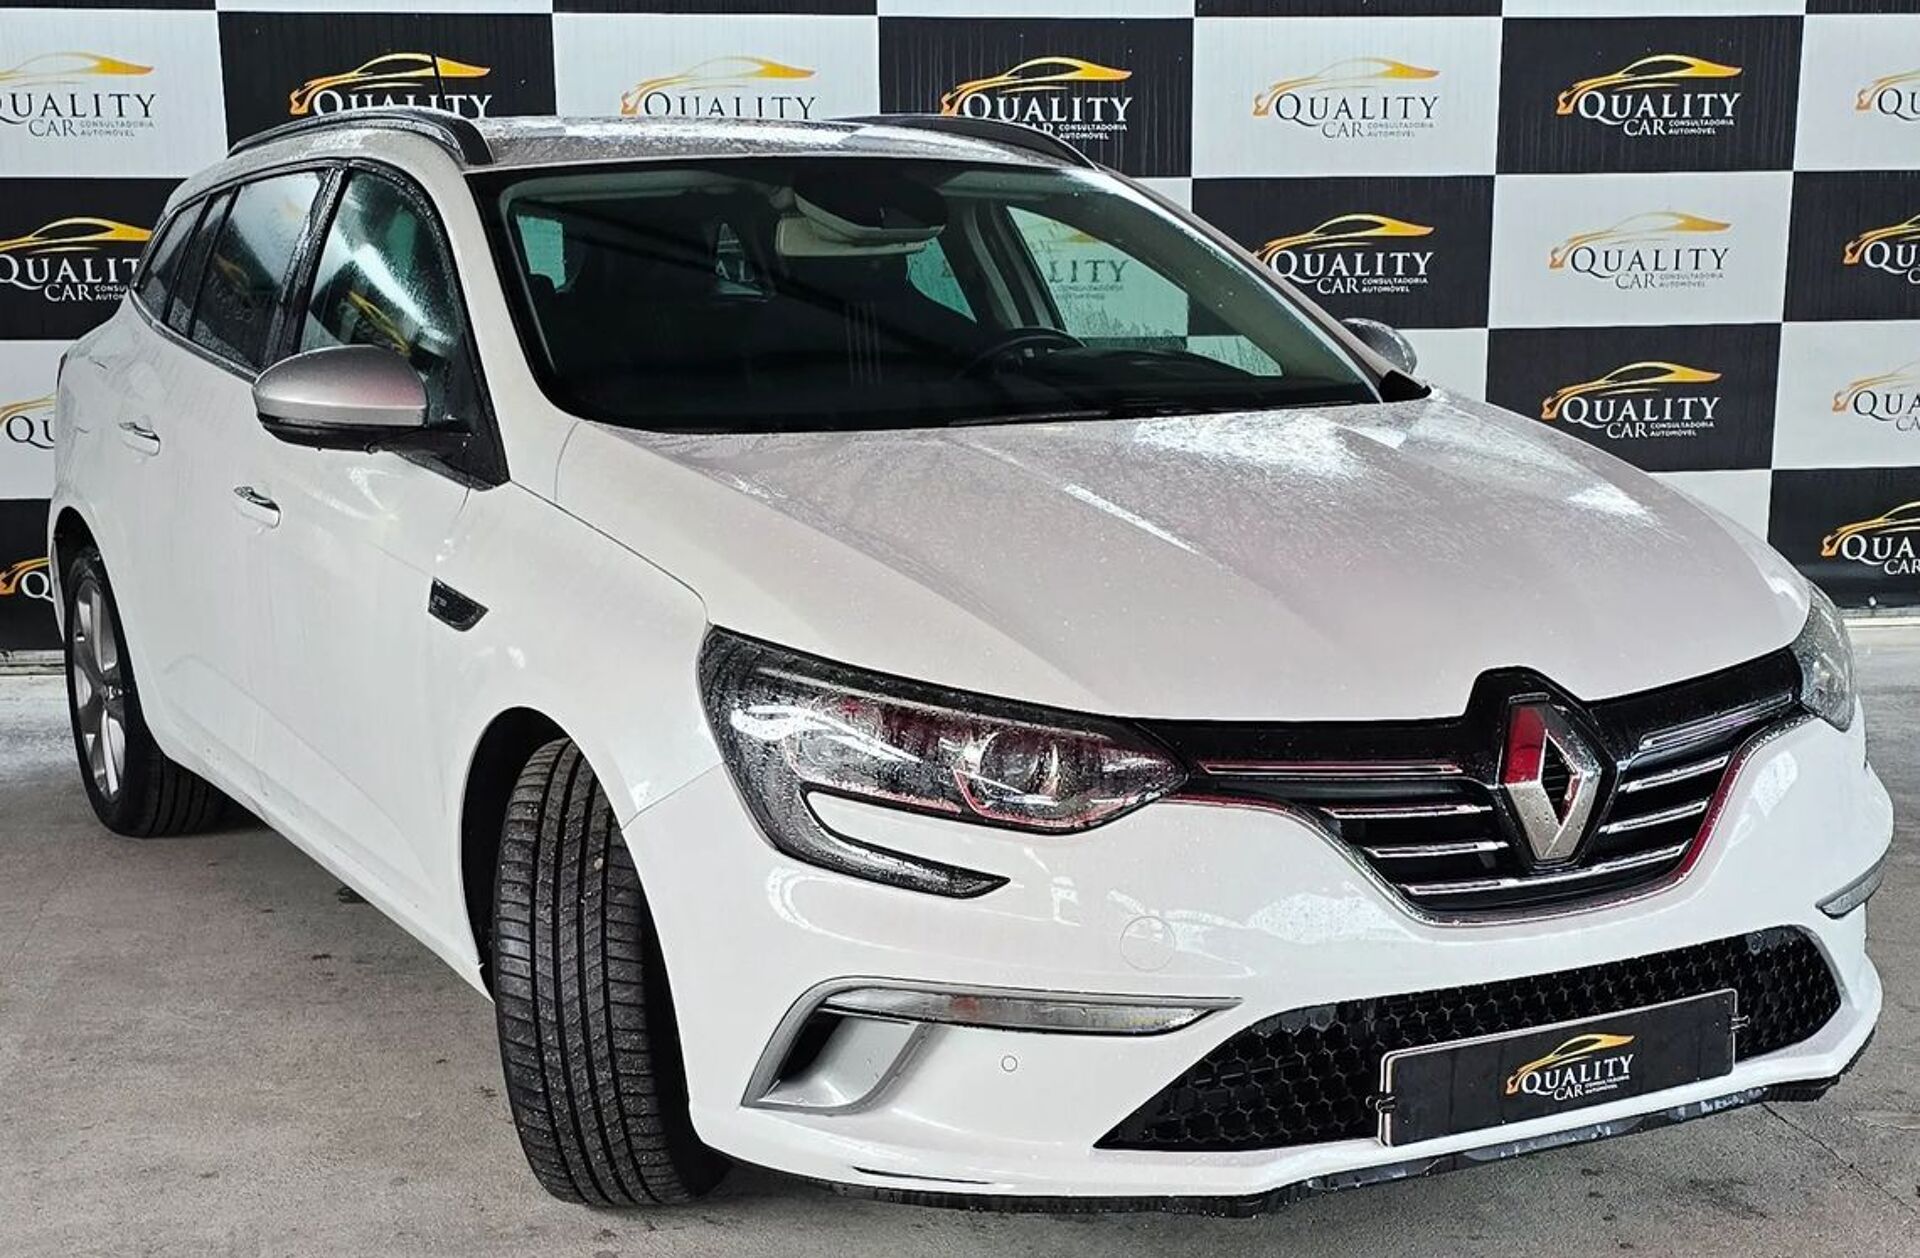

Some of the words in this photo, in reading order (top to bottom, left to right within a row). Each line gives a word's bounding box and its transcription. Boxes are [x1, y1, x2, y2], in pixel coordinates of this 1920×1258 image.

[0, 92, 156, 124] UALITY
[963, 93, 1132, 122] QUALITY
[1275, 93, 1440, 127] QUALITY
[1578, 91, 1741, 125] QUALITY
[28, 119, 77, 137] CAR
[1322, 121, 1364, 138] CAR
[1623, 119, 1666, 136] CAR
[1271, 251, 1433, 284] QUALITY
[1571, 247, 1729, 279] QUALITY
[1317, 277, 1359, 294] CAR
[1615, 272, 1656, 289] CAR
[44, 284, 93, 302] CAR
[1562, 397, 1720, 428] QUALITY
[1606, 422, 1648, 438] CAR
[1521, 1054, 1634, 1095] QUALITY
[1554, 1084, 1583, 1100] CAR
